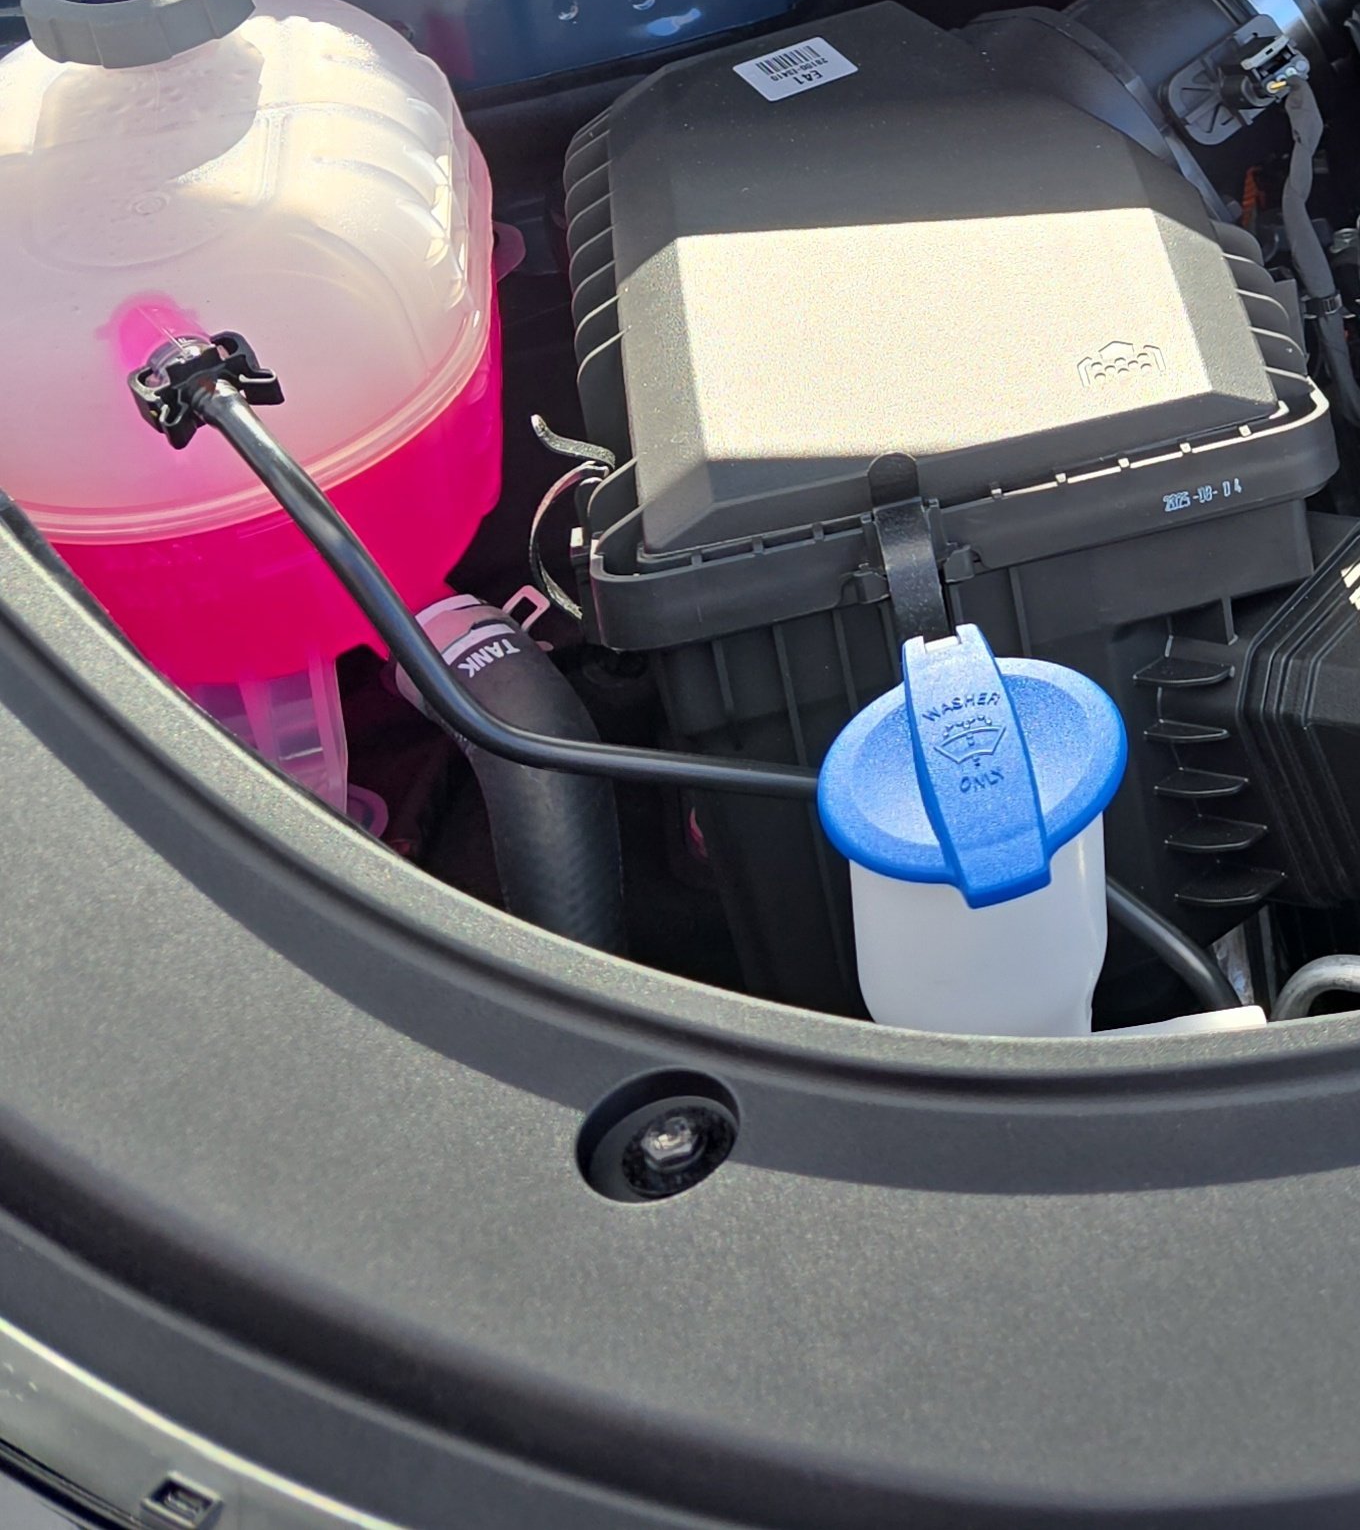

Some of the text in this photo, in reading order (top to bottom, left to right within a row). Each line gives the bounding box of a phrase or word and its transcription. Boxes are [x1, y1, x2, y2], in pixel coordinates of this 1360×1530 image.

[457, 638, 521, 678] TANK
[922, 692, 1000, 722] WASHER
[959, 768, 1005, 793] ONLY
